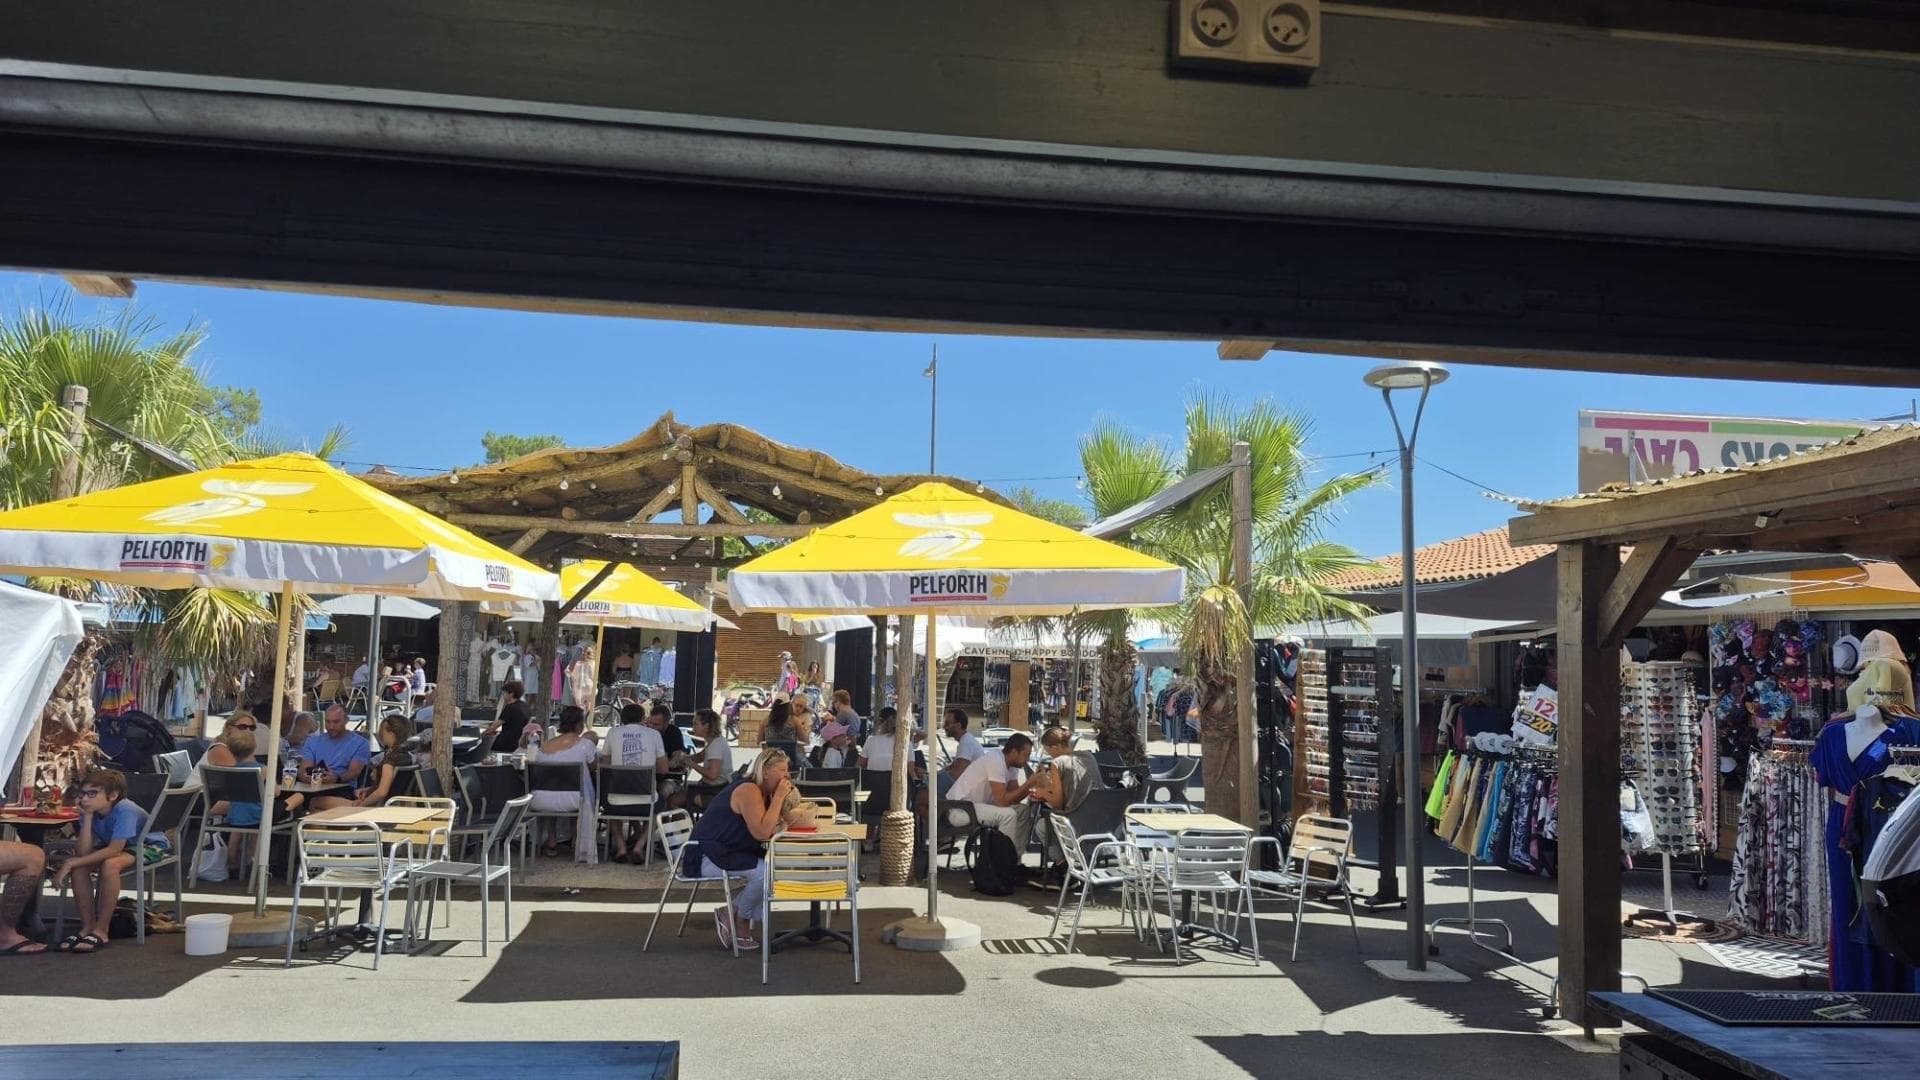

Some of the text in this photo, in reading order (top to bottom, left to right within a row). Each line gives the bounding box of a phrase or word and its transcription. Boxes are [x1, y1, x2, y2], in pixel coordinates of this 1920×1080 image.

[121, 540, 208, 562] PELFORTH
[910, 575, 987, 595] PELFORTH
[575, 600, 610, 611] ELFORTH
